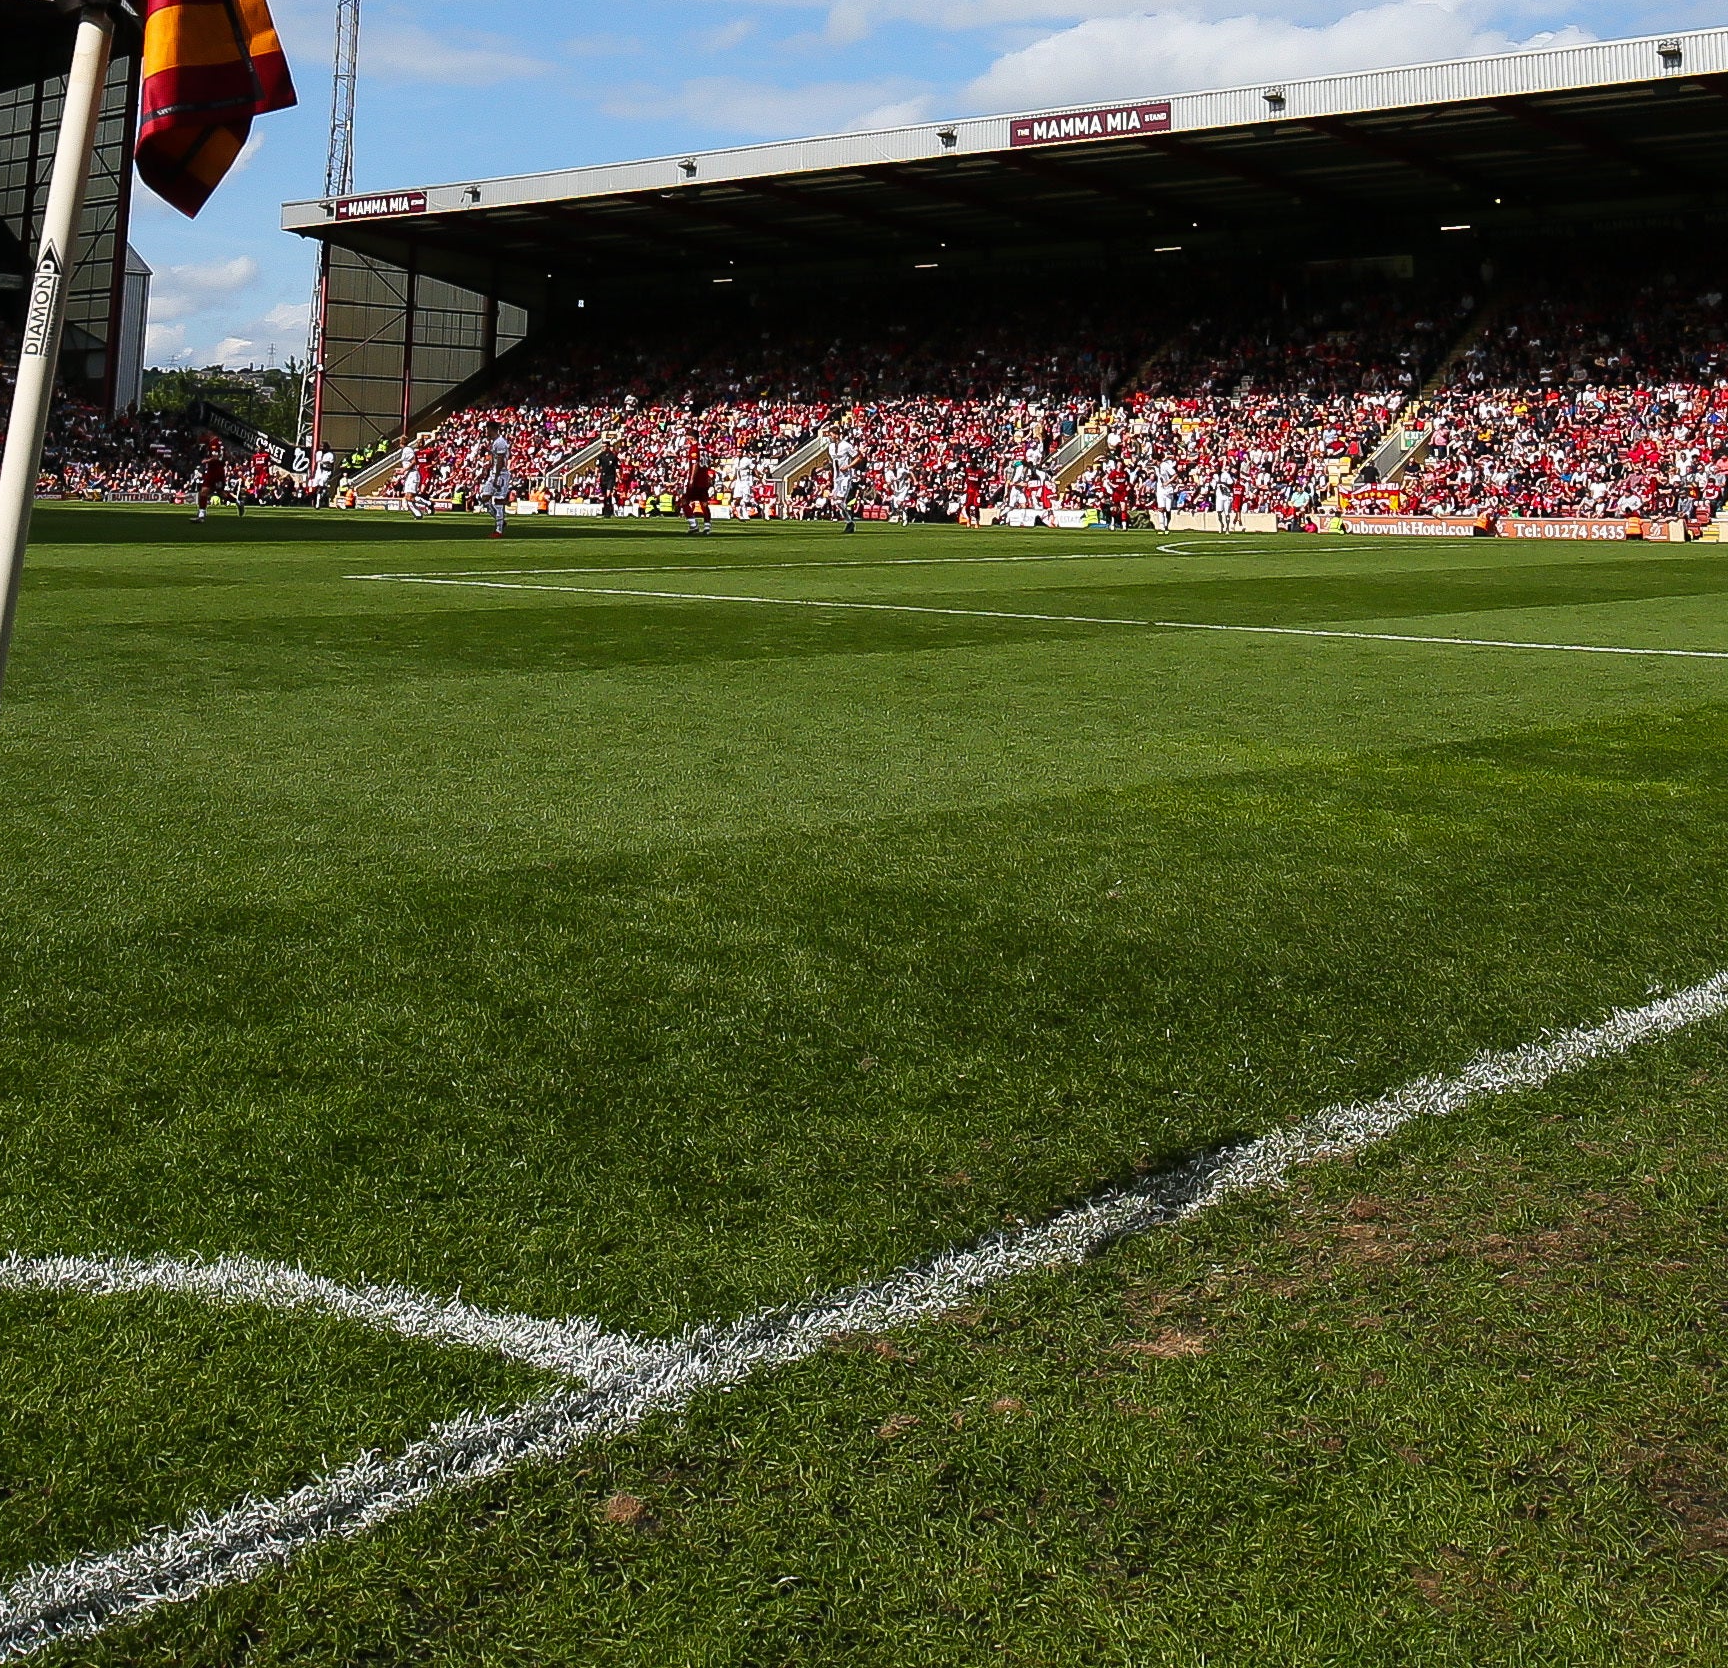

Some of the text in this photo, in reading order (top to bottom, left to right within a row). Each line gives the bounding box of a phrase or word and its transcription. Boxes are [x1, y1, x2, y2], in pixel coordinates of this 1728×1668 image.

[1032, 114, 1103, 141] MAMMA
[1106, 110, 1141, 133] MIA
[348, 198, 387, 217] MAMMA
[389, 196, 410, 213] MIA
[23, 259, 55, 356] DIAMOND
[1513, 523, 1626, 540] Tel: 01274 5435
